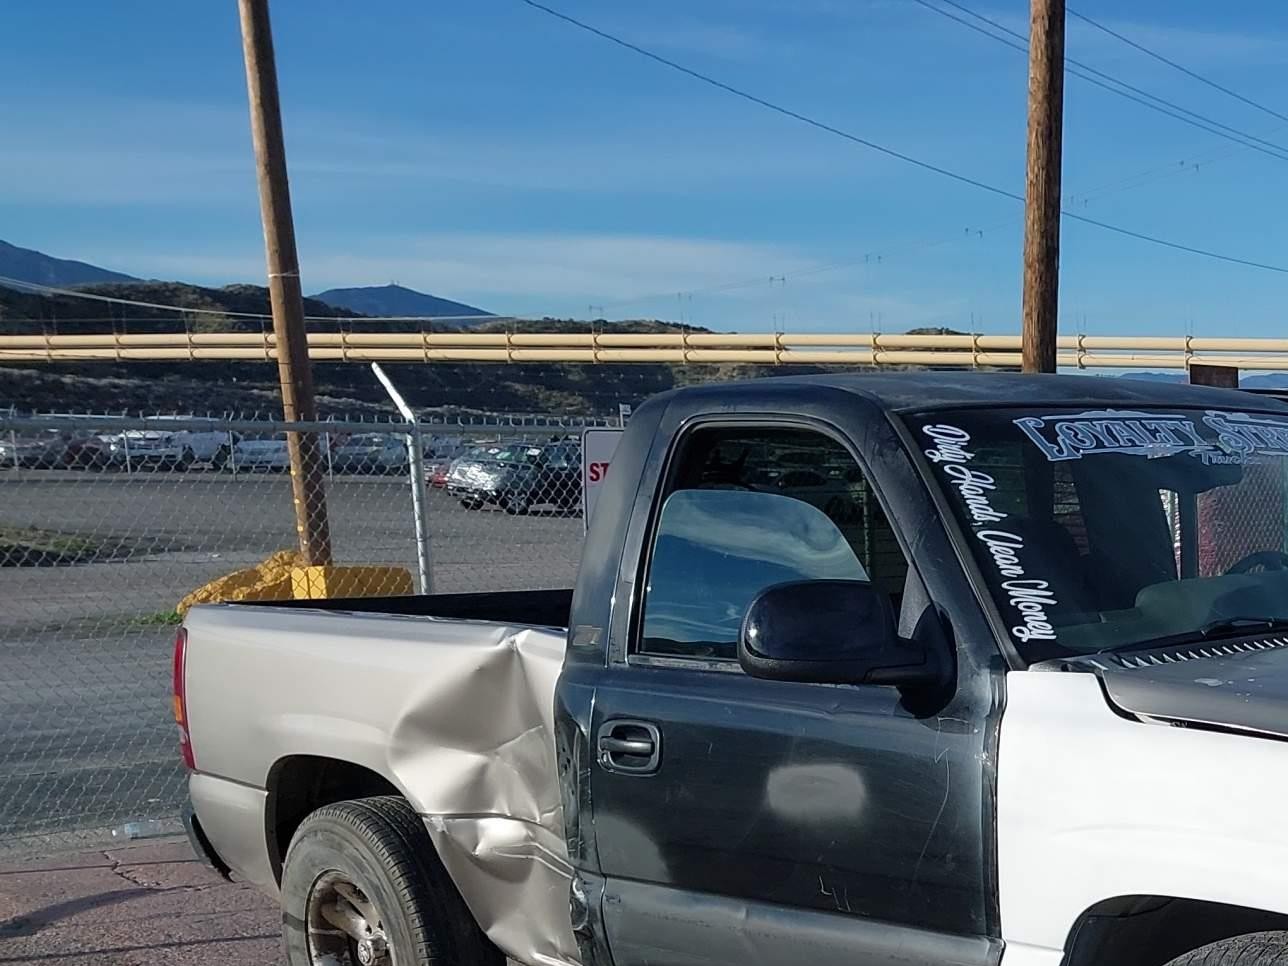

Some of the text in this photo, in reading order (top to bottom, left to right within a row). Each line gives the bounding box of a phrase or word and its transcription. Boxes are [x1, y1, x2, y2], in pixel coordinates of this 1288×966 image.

[1013, 415, 1207, 461] LOYALTY
[922, 424, 975, 463] Dirty
[976, 530, 1024, 578] Clean
[1001, 579, 1058, 643] Money
